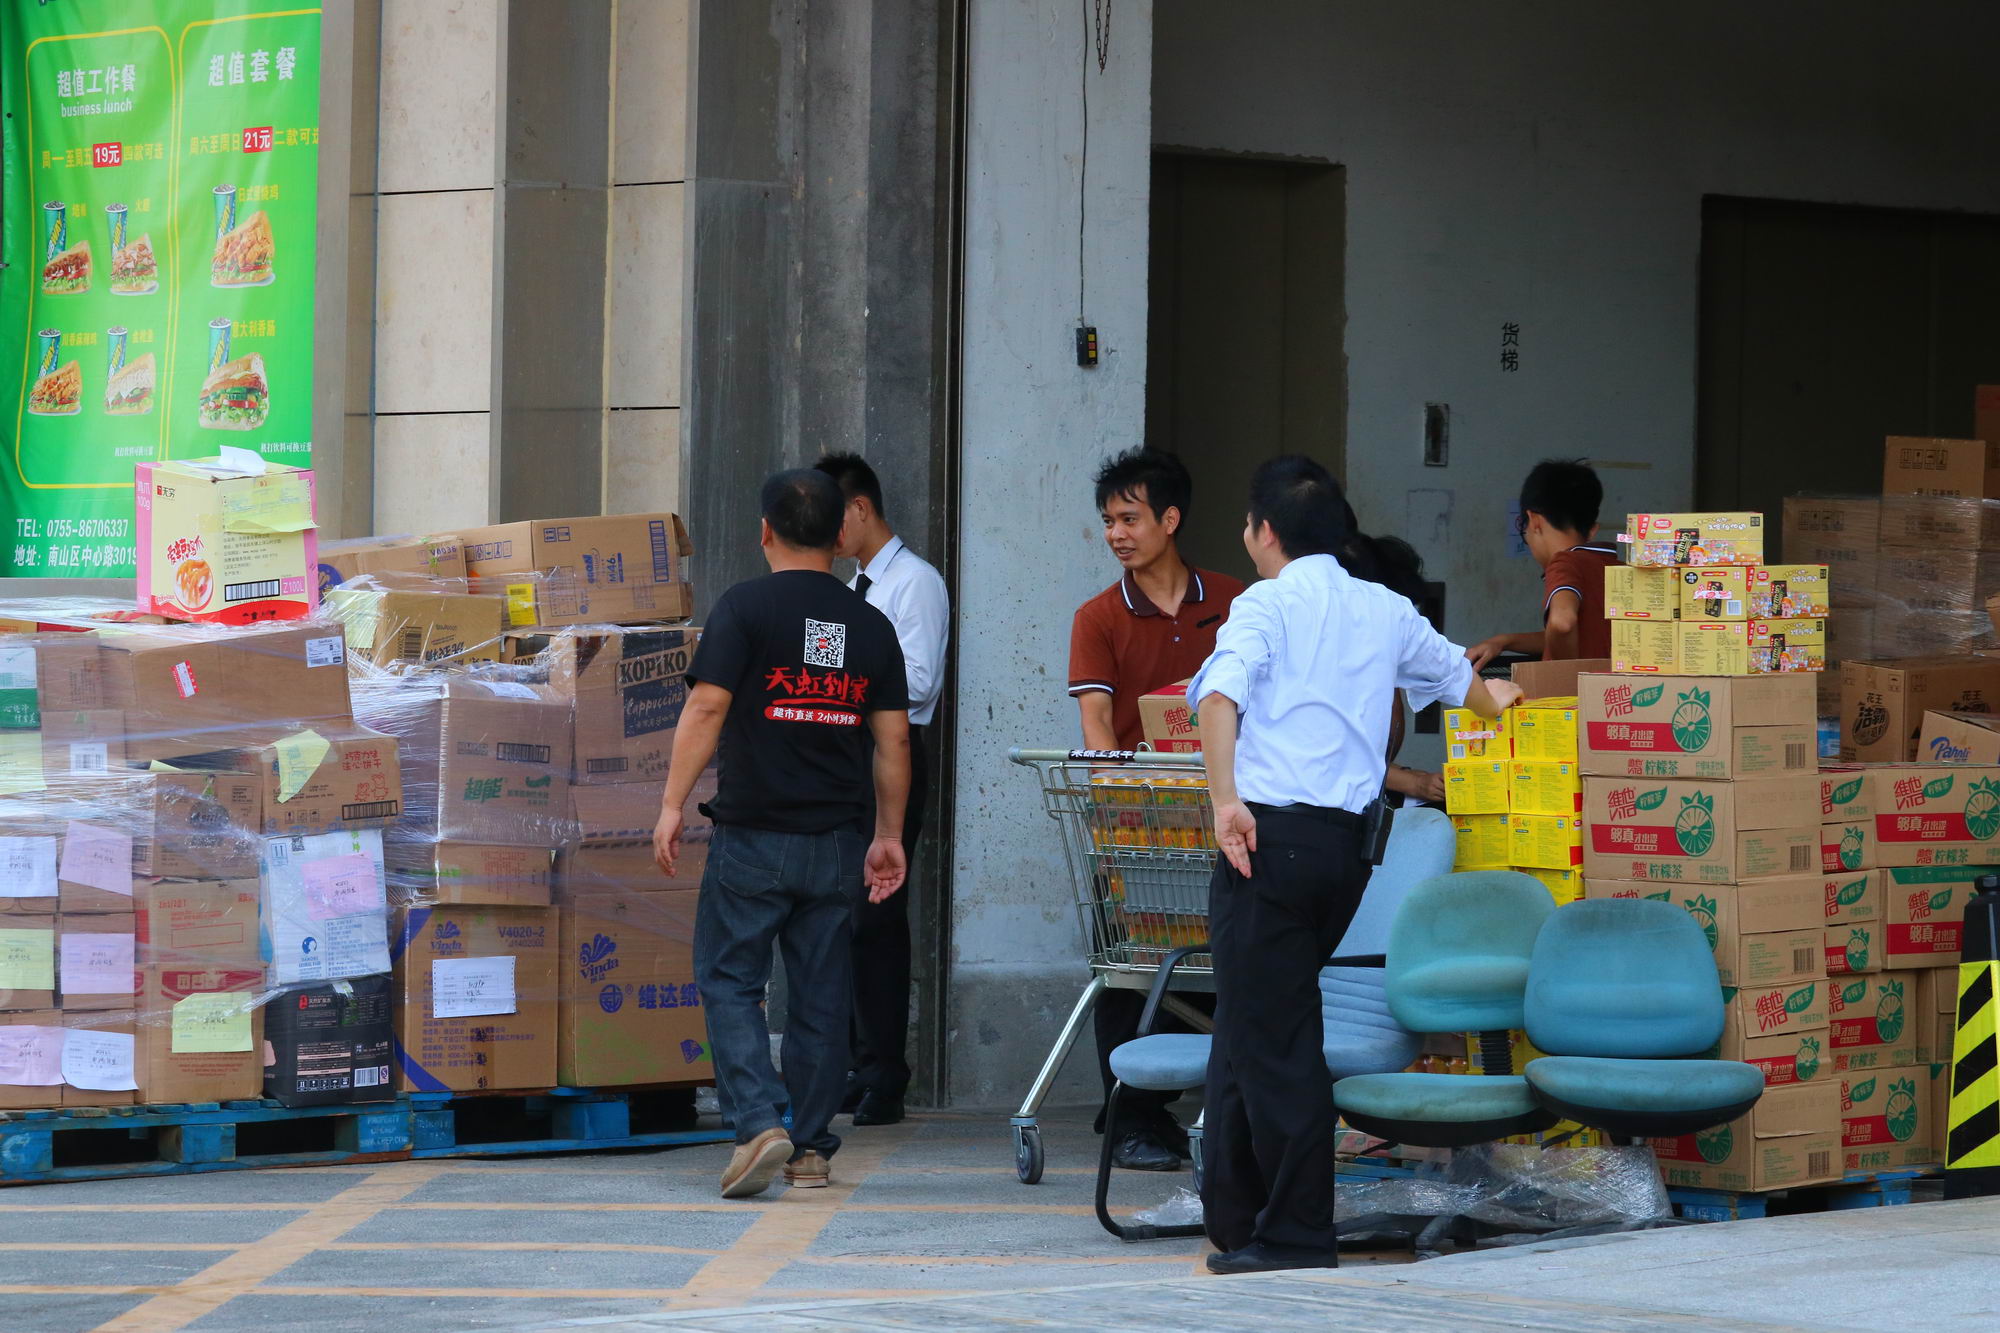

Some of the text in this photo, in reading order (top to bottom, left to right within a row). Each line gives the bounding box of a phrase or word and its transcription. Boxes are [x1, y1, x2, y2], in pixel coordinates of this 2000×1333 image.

[208, 47, 296, 87] 超值套餐
[57, 64, 136, 98] 超值工作餐
[61, 98, 132, 117] business lunch
[245, 130, 270, 149] 21元
[95, 145, 120, 163] 19元
[1500, 322, 1519, 372] 货梯
[16, 519, 129, 538] TEL: 0755-86706337
[619, 650, 688, 684] KOPIKO
[764, 667, 869, 703] 天虹到家
[1866, 692, 1884, 705] 花王
[772, 707, 857, 725] 超市直送 2小时到家
[1645, 760, 1679, 777] 柠檬茶
[463, 777, 503, 802] 超能
[1934, 849, 1970, 864] 柠檬茶
[1650, 864, 1683, 880] 柠檬茶
[497, 926, 545, 938] V4020-2
[431, 940, 462, 950] Vinda
[580, 957, 620, 979] Vinda
[638, 983, 703, 1009] 维达纸
